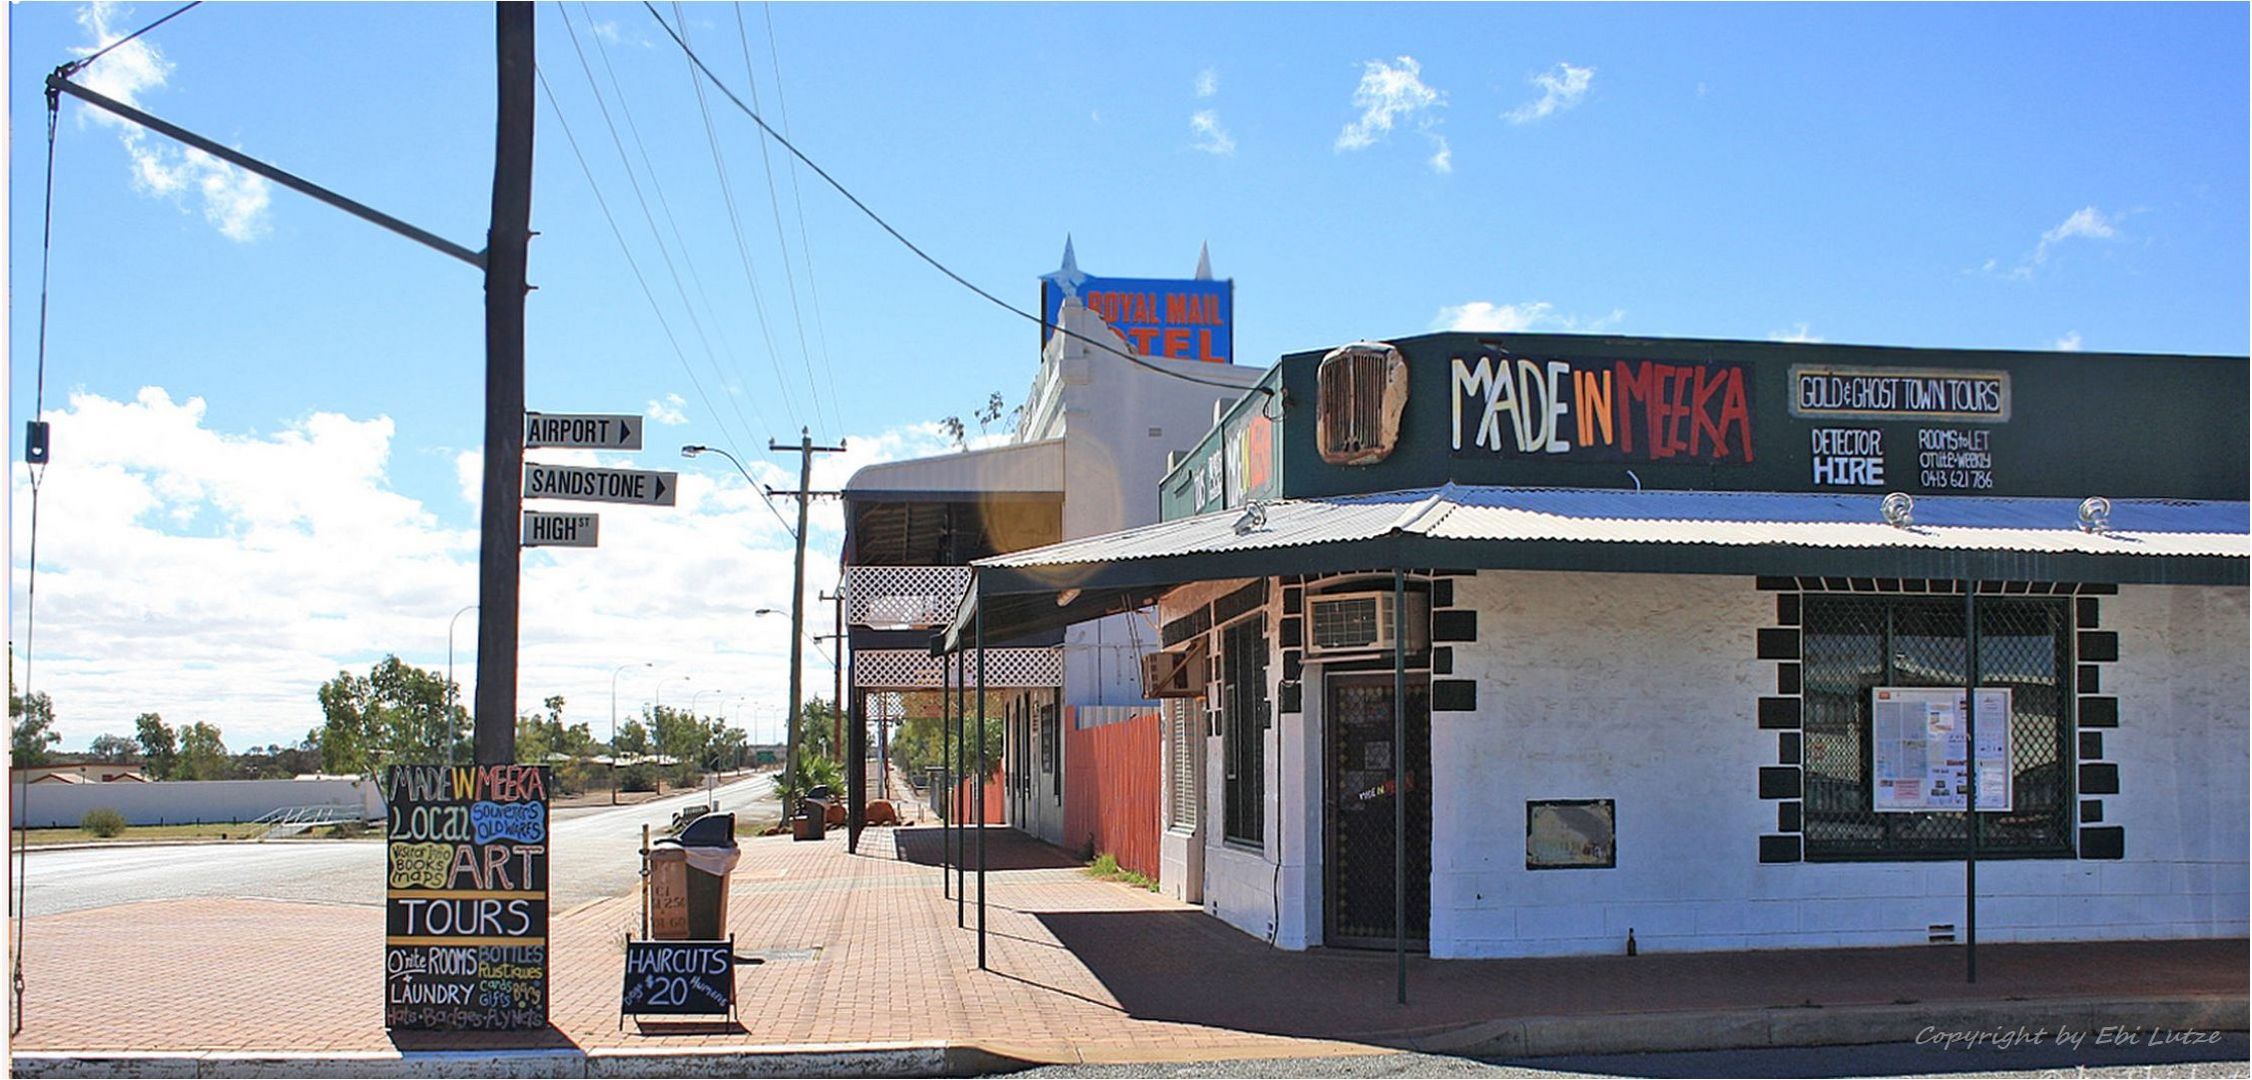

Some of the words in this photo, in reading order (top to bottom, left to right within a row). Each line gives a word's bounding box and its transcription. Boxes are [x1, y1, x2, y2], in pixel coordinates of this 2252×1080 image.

[1088, 291, 1160, 324] ROYAL
[1166, 293, 1223, 325] MAIL
[1108, 327, 1225, 363] TEL
[1800, 376, 1843, 408] GOLD
[1852, 377, 1899, 409] GHOST
[1902, 378, 1945, 411] TOWN
[1946, 379, 2000, 412] TOURS
[1451, 356, 1570, 452] MADE
[1573, 369, 1613, 447] IN
[1616, 360, 1754, 462] MEEKA
[528, 419, 610, 442] AIRPORT
[1811, 429, 1883, 456] DETECTOR
[1919, 429, 1957, 450] ROOMS
[1968, 430, 1990, 451] LET
[532, 469, 645, 499] SANDSTONE
[1813, 457, 1885, 485] HIRE
[1921, 470, 1947, 487] 0413
[1950, 470, 1968, 487] 621
[1971, 471, 1993, 488] 786
[533, 517, 576, 540] HIGH
[578, 517, 590, 527] ST
[390, 765, 450, 801] MADE
[475, 765, 547, 801] MEEKA
[478, 821, 504, 839] OLD
[447, 845, 545, 890] ART
[399, 900, 531, 936] TOURS
[428, 947, 477, 976] ROOMS
[478, 945, 543, 964] BOTTLES
[627, 948, 729, 974] HAIRCUTS
[391, 984, 474, 1005] LAUNDRY
